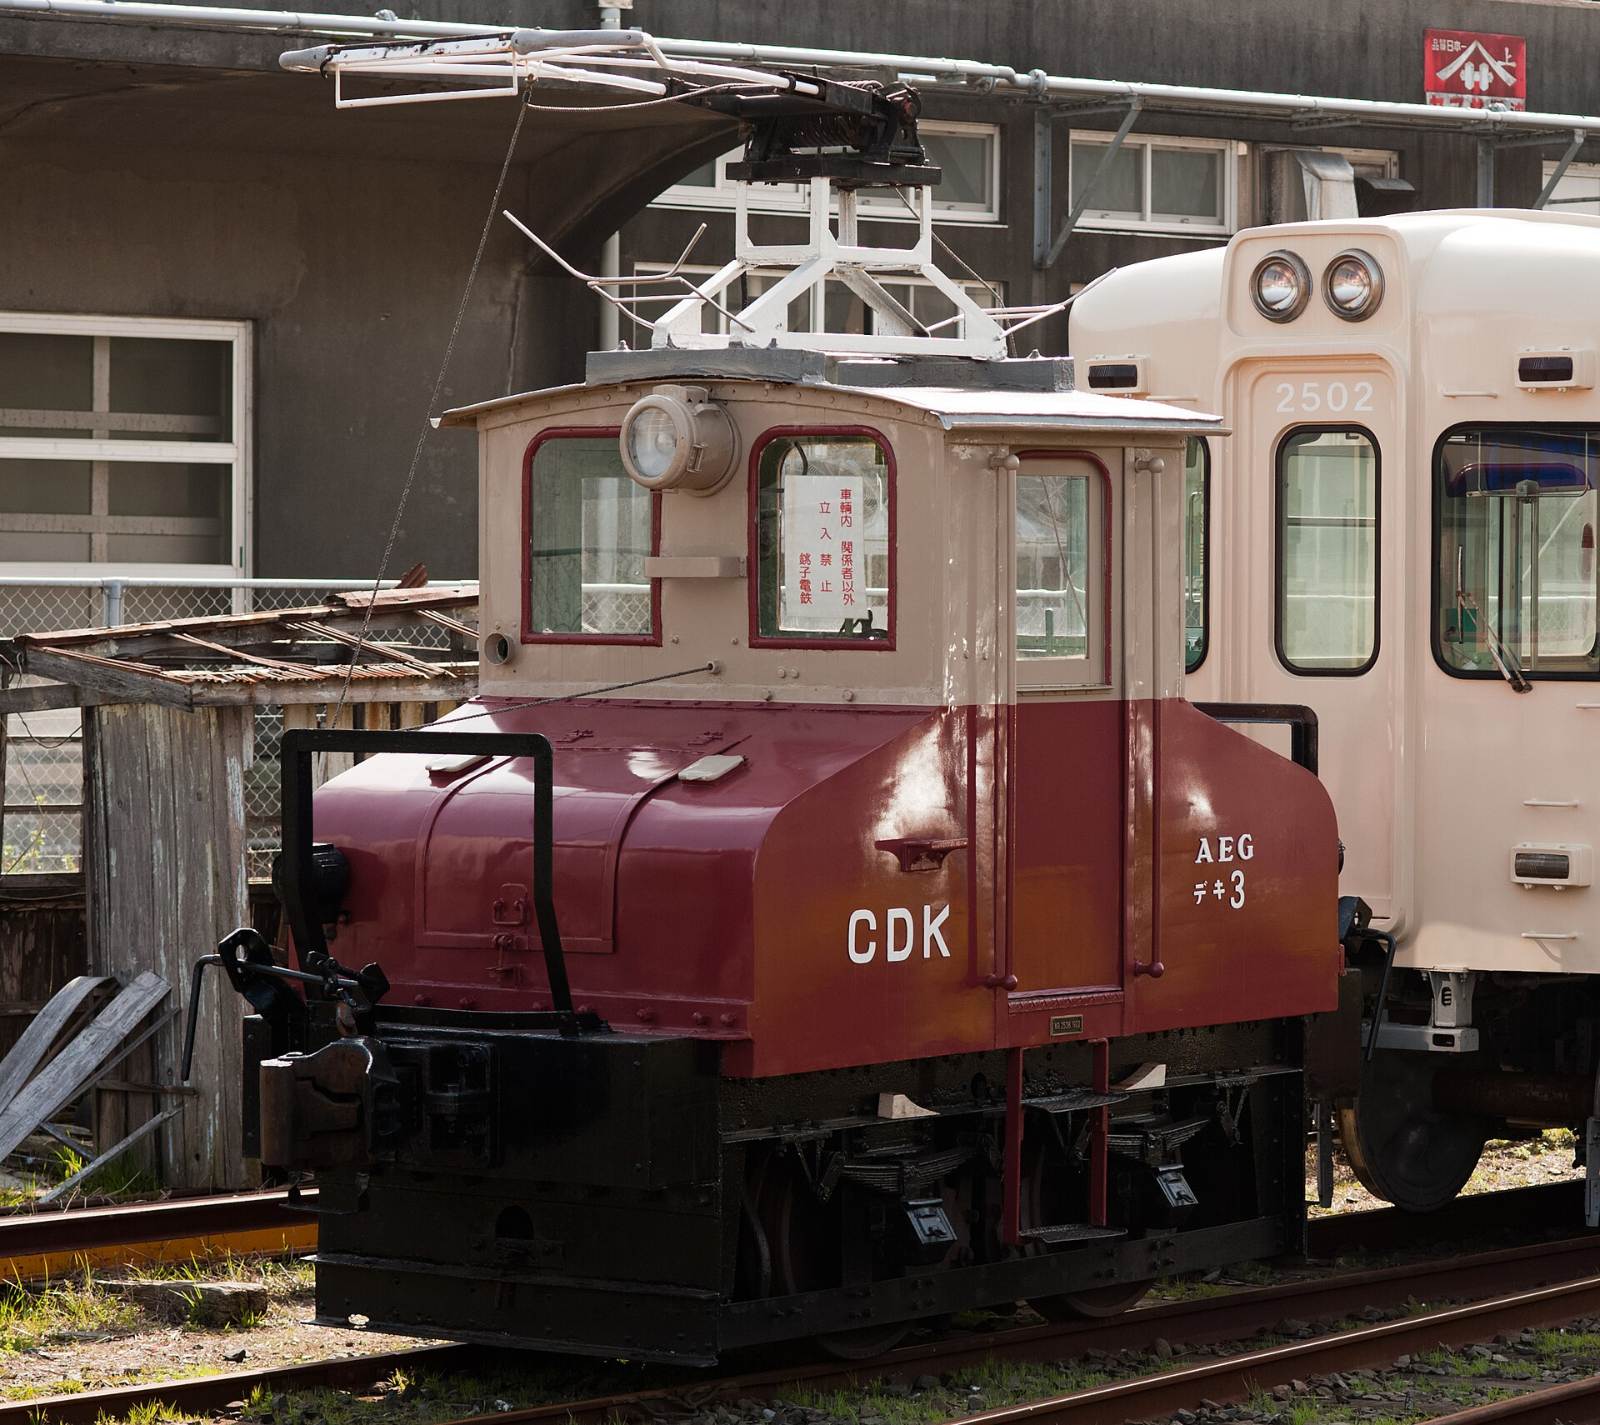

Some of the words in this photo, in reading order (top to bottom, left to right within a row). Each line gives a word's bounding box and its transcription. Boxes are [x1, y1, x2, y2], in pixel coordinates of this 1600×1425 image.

[1276, 382, 1374, 412] 2502
[819, 501, 832, 593] 立入禁止
[841, 541, 855, 606] 関係者以外
[799, 552, 813, 605] 銚子電鉄
[1194, 833, 1254, 864] AEG
[848, 904, 951, 964] CDK
